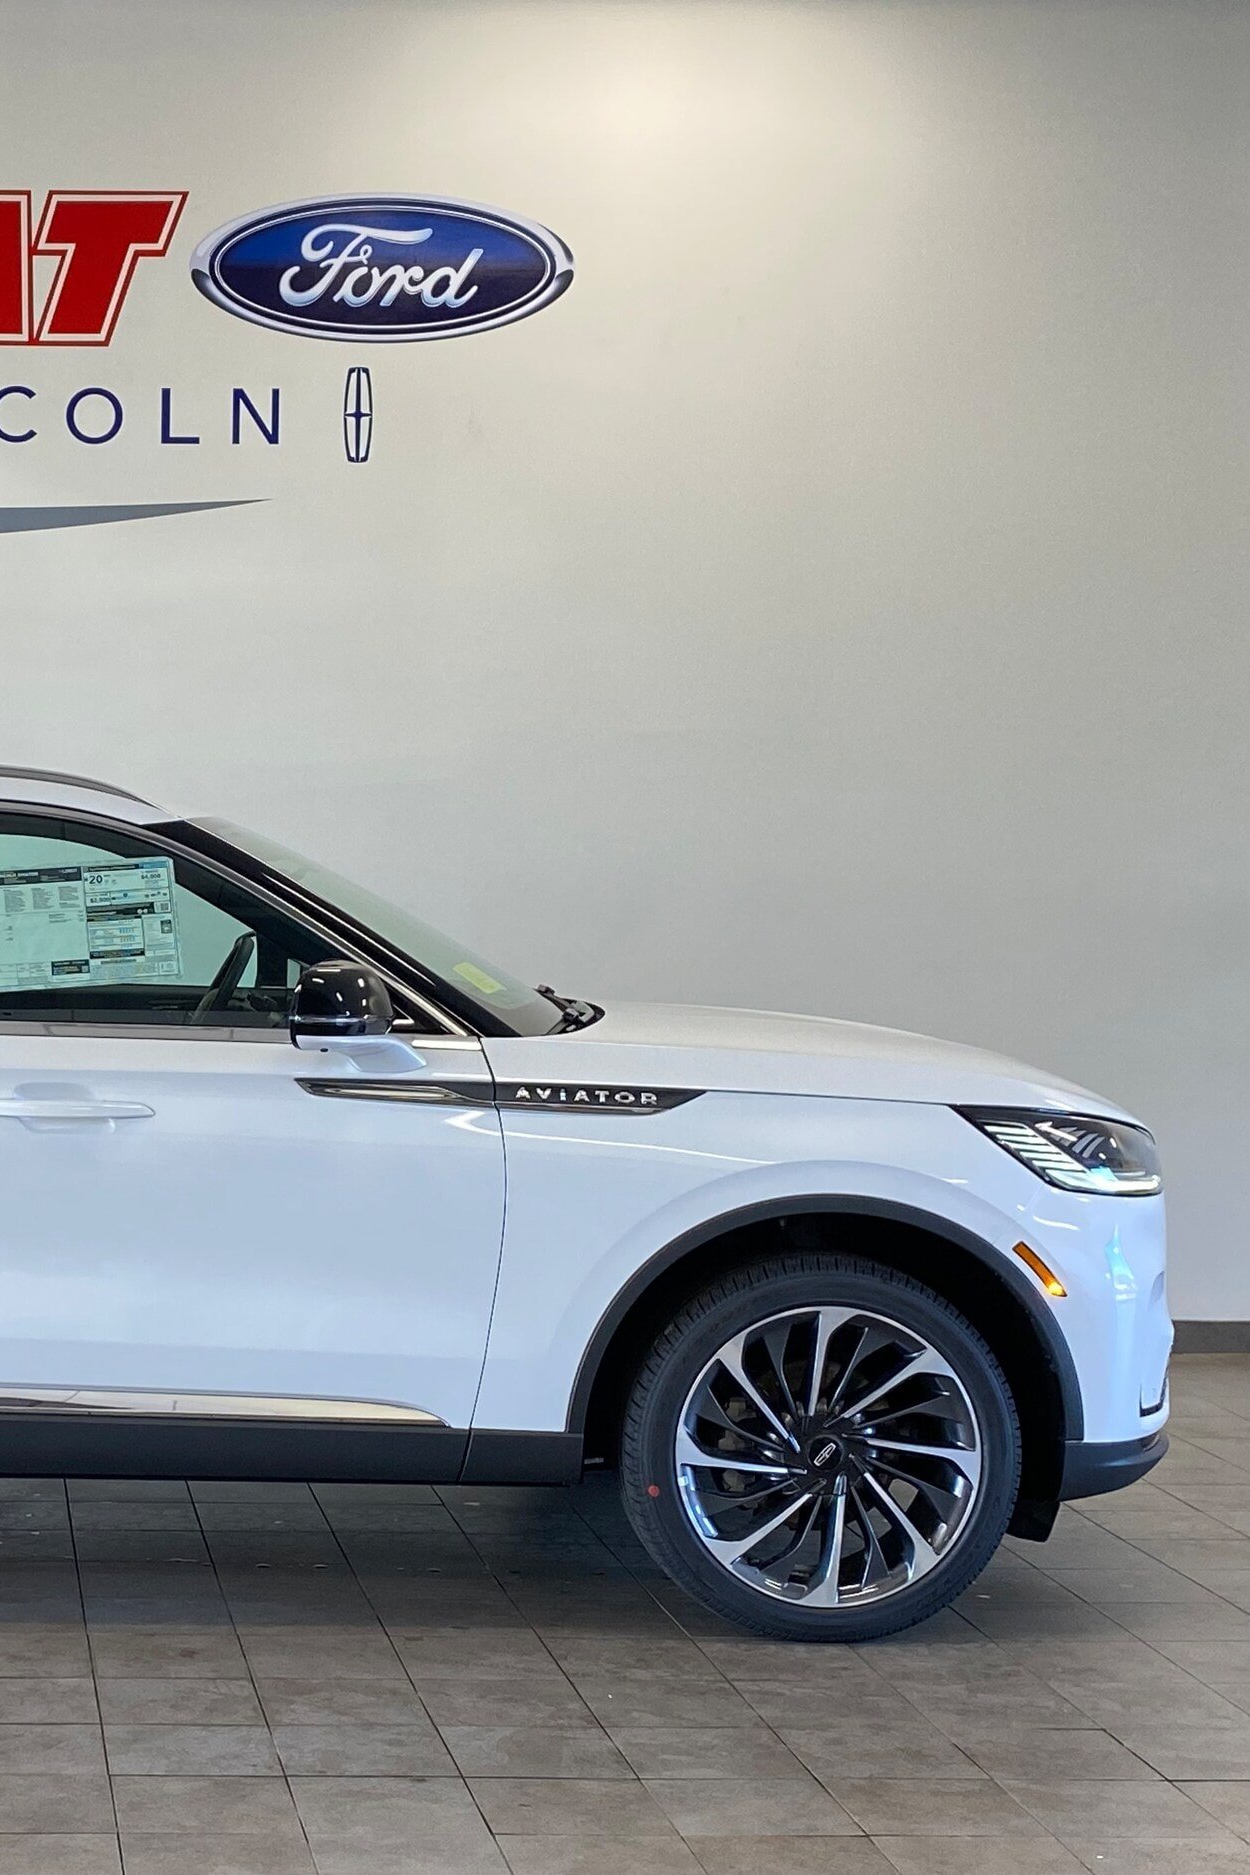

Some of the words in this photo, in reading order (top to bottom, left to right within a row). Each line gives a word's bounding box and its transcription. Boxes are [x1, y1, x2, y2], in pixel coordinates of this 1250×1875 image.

[279, 223, 484, 308] Ford
[89, 874, 103, 884] 20
[515, 1086, 658, 1105] AVIATOR
